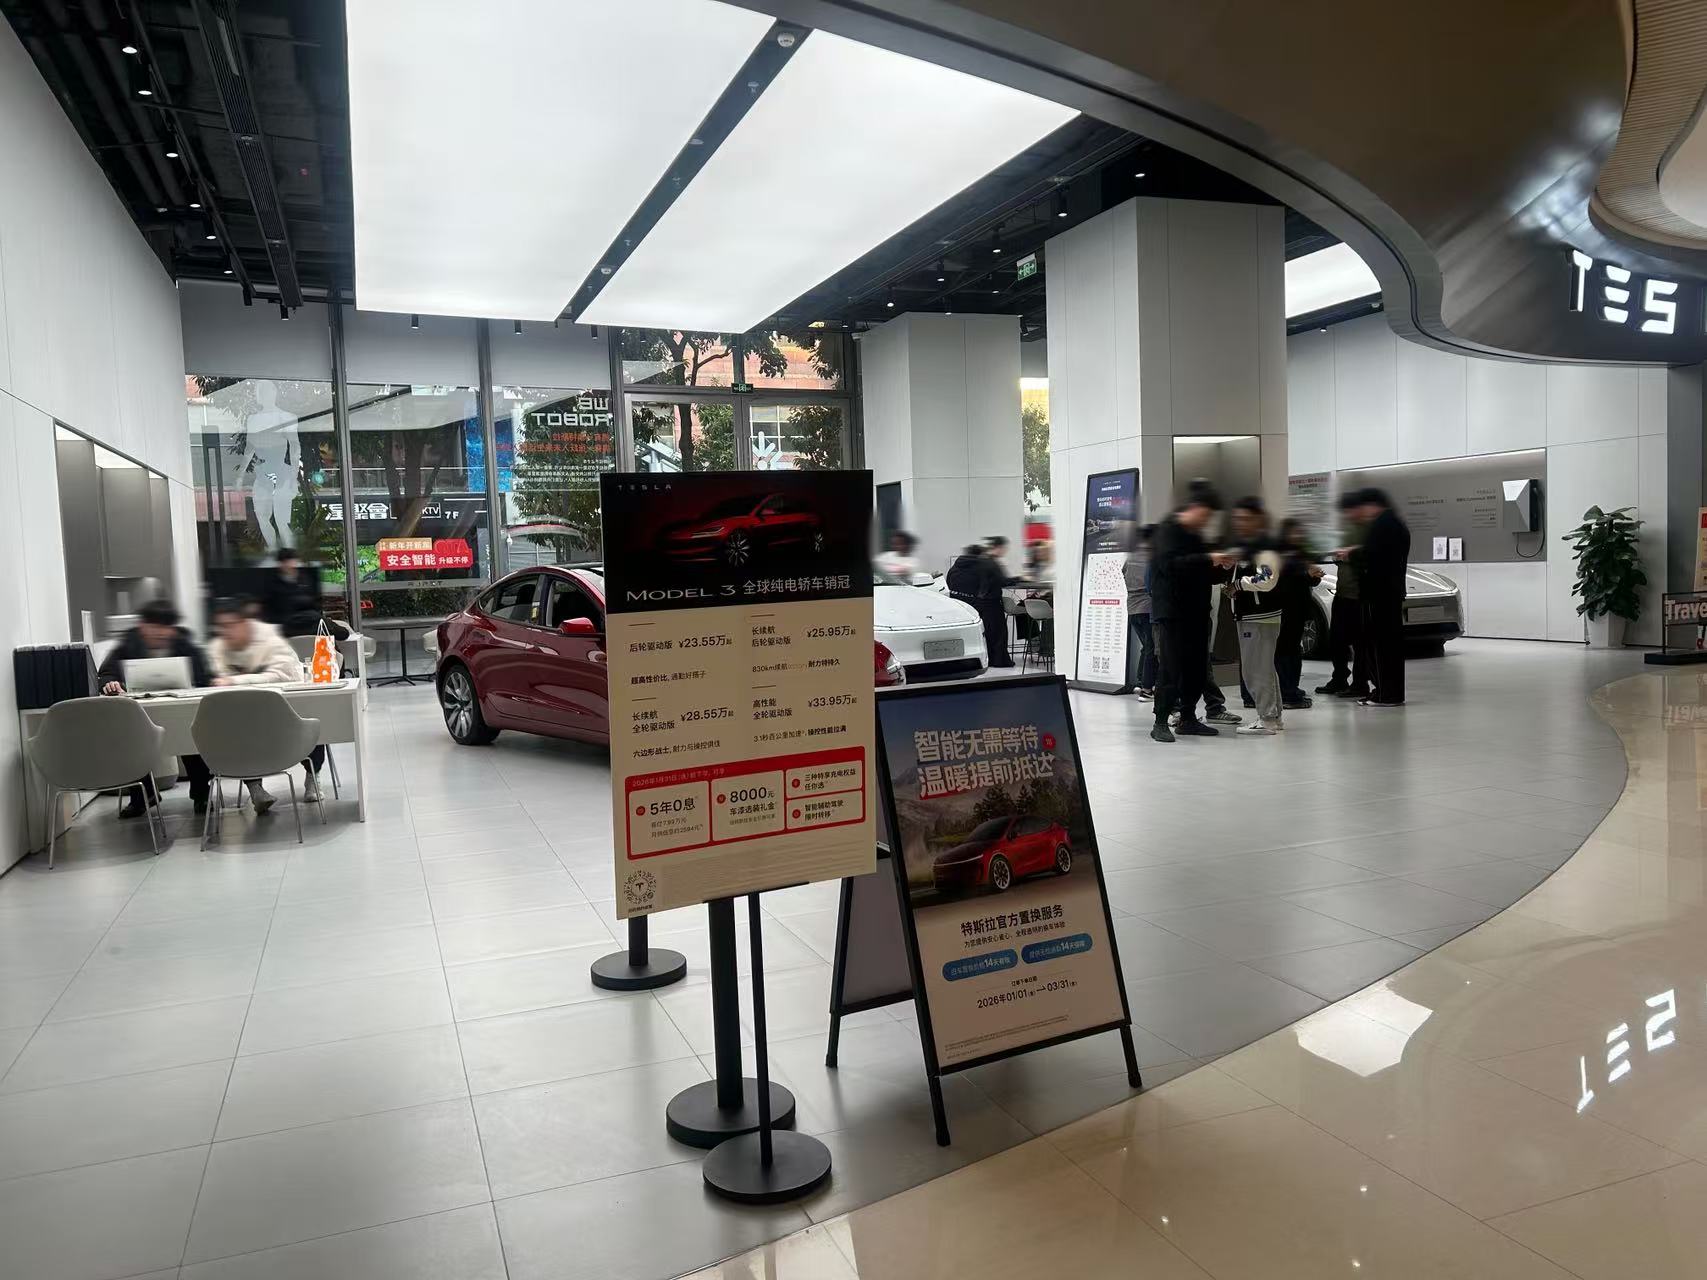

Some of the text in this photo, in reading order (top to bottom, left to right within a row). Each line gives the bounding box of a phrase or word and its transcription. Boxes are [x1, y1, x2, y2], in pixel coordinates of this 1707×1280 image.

[1573, 249, 1707, 335] TES
[387, 553, 436, 566] 安全智能
[626, 574, 850, 601] MODEL 3 全球纯电轿车销冠
[752, 626, 775, 635] 长续航
[630, 640, 673, 652] 后轮驱动版
[752, 636, 791, 648] 后轮驱动版
[752, 698, 777, 708] 高性能
[632, 710, 659, 721] 长续航
[753, 708, 792, 720] 全轮驱动版
[632, 720, 675, 734] 全轮驱动版
[914, 724, 1038, 762] 智能无需等待
[918, 751, 1056, 799] 温暖提前抵达
[730, 786, 775, 803] 8000元
[650, 797, 696, 815] 5年0息
[960, 904, 1064, 937] 特斯拉官方置换服务
